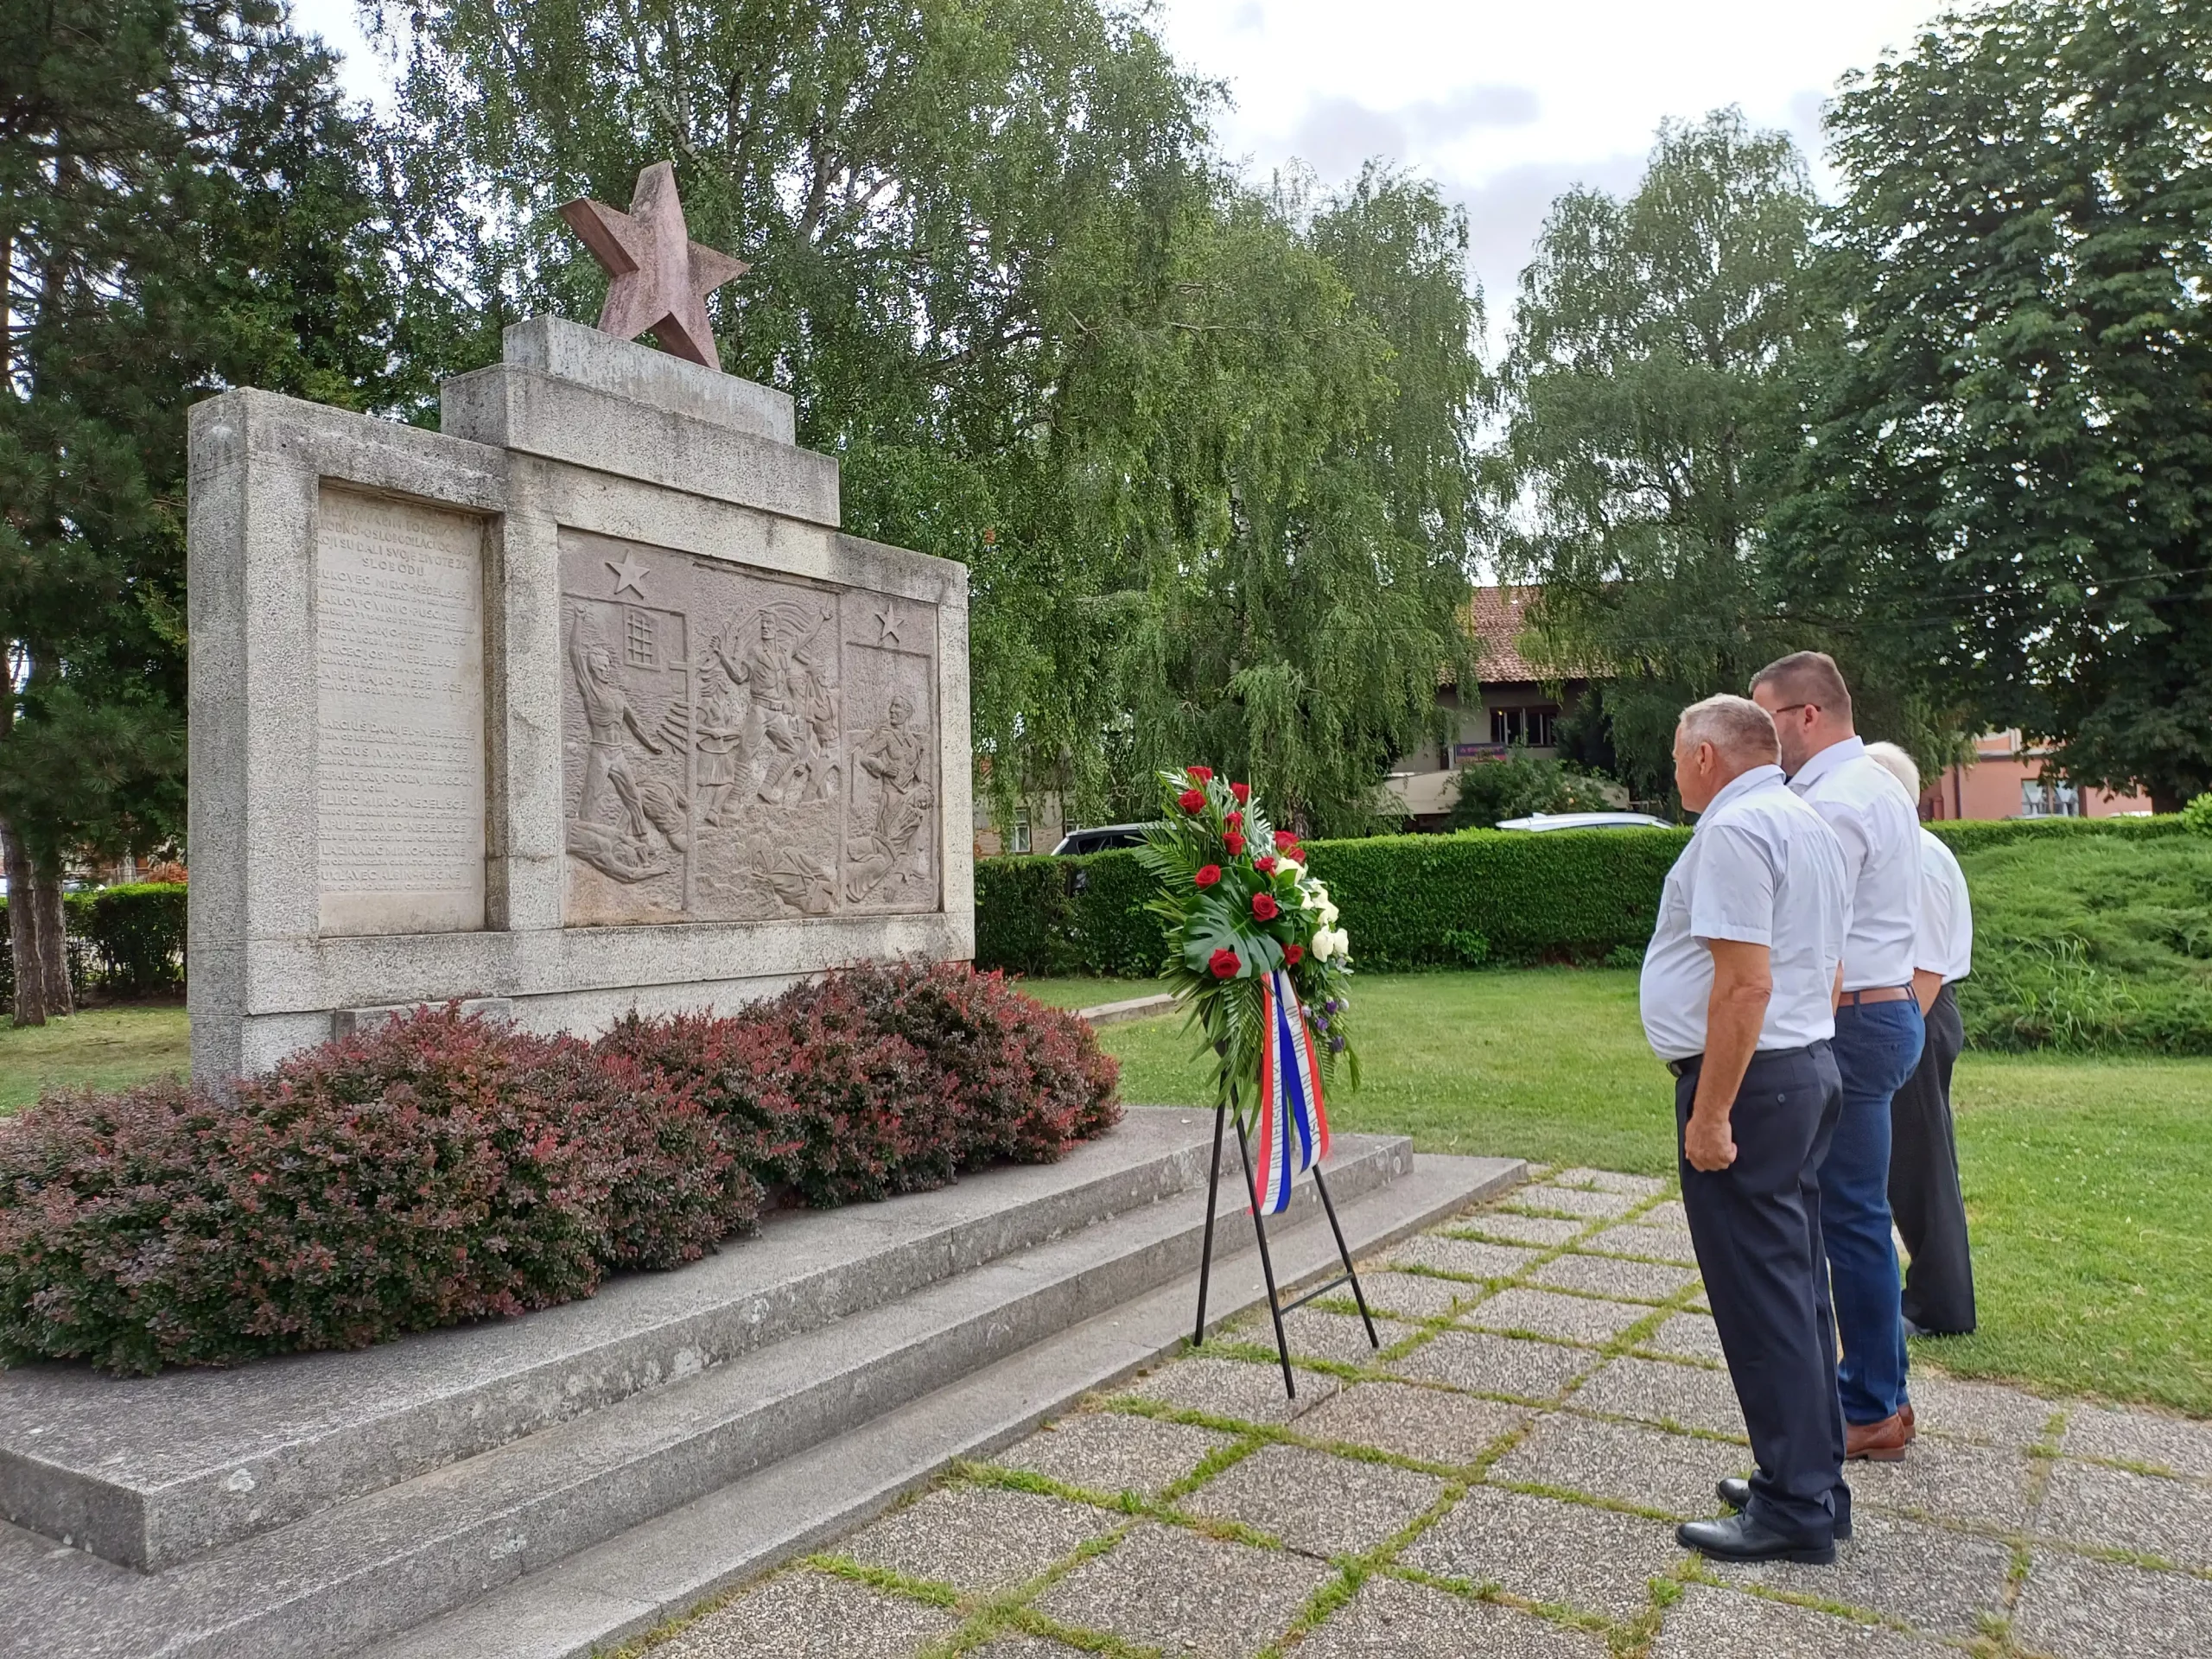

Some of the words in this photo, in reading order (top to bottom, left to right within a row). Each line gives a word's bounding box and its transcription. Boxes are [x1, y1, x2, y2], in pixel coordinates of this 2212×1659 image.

[340, 538, 353, 550] SU
[357, 543, 382, 555] DALI
[385, 548, 416, 563] SVOJE
[361, 558, 424, 575] SLOBODU
